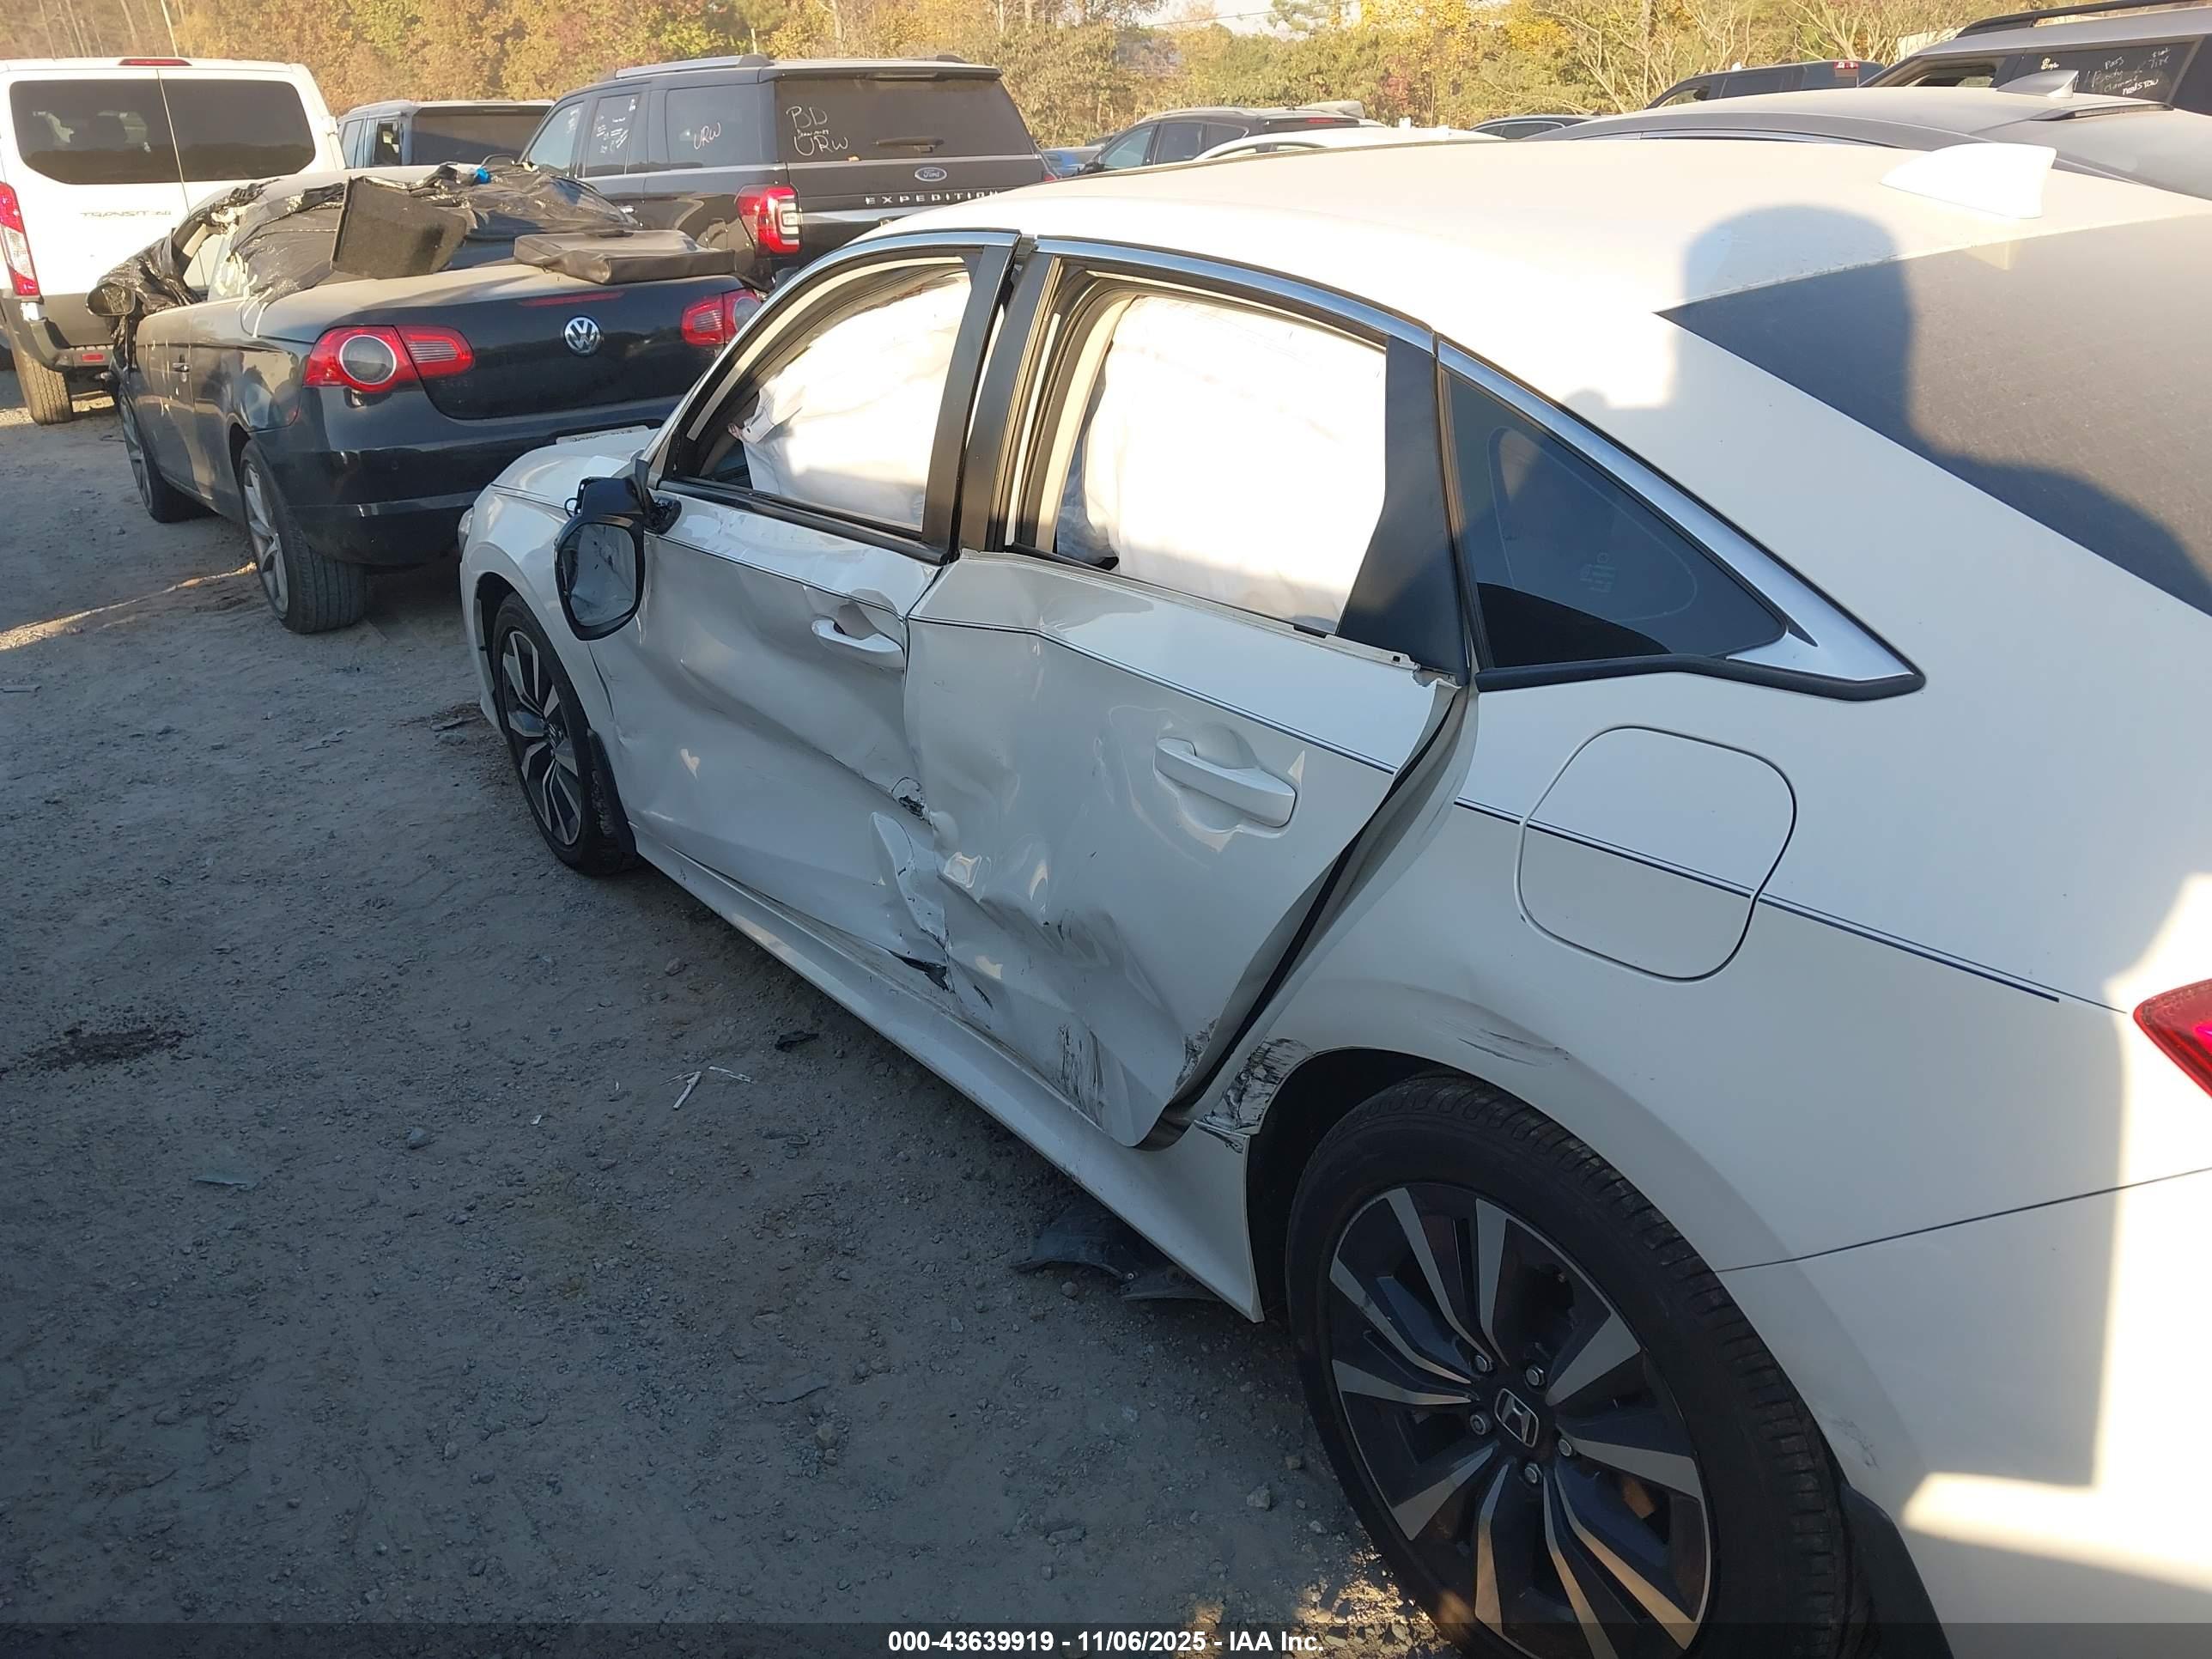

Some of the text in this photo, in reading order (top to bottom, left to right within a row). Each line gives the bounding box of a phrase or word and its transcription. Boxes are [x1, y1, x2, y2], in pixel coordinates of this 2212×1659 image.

[786, 106, 828, 128] BD
[693, 122, 721, 149] URW
[793, 135, 848, 156] URW
